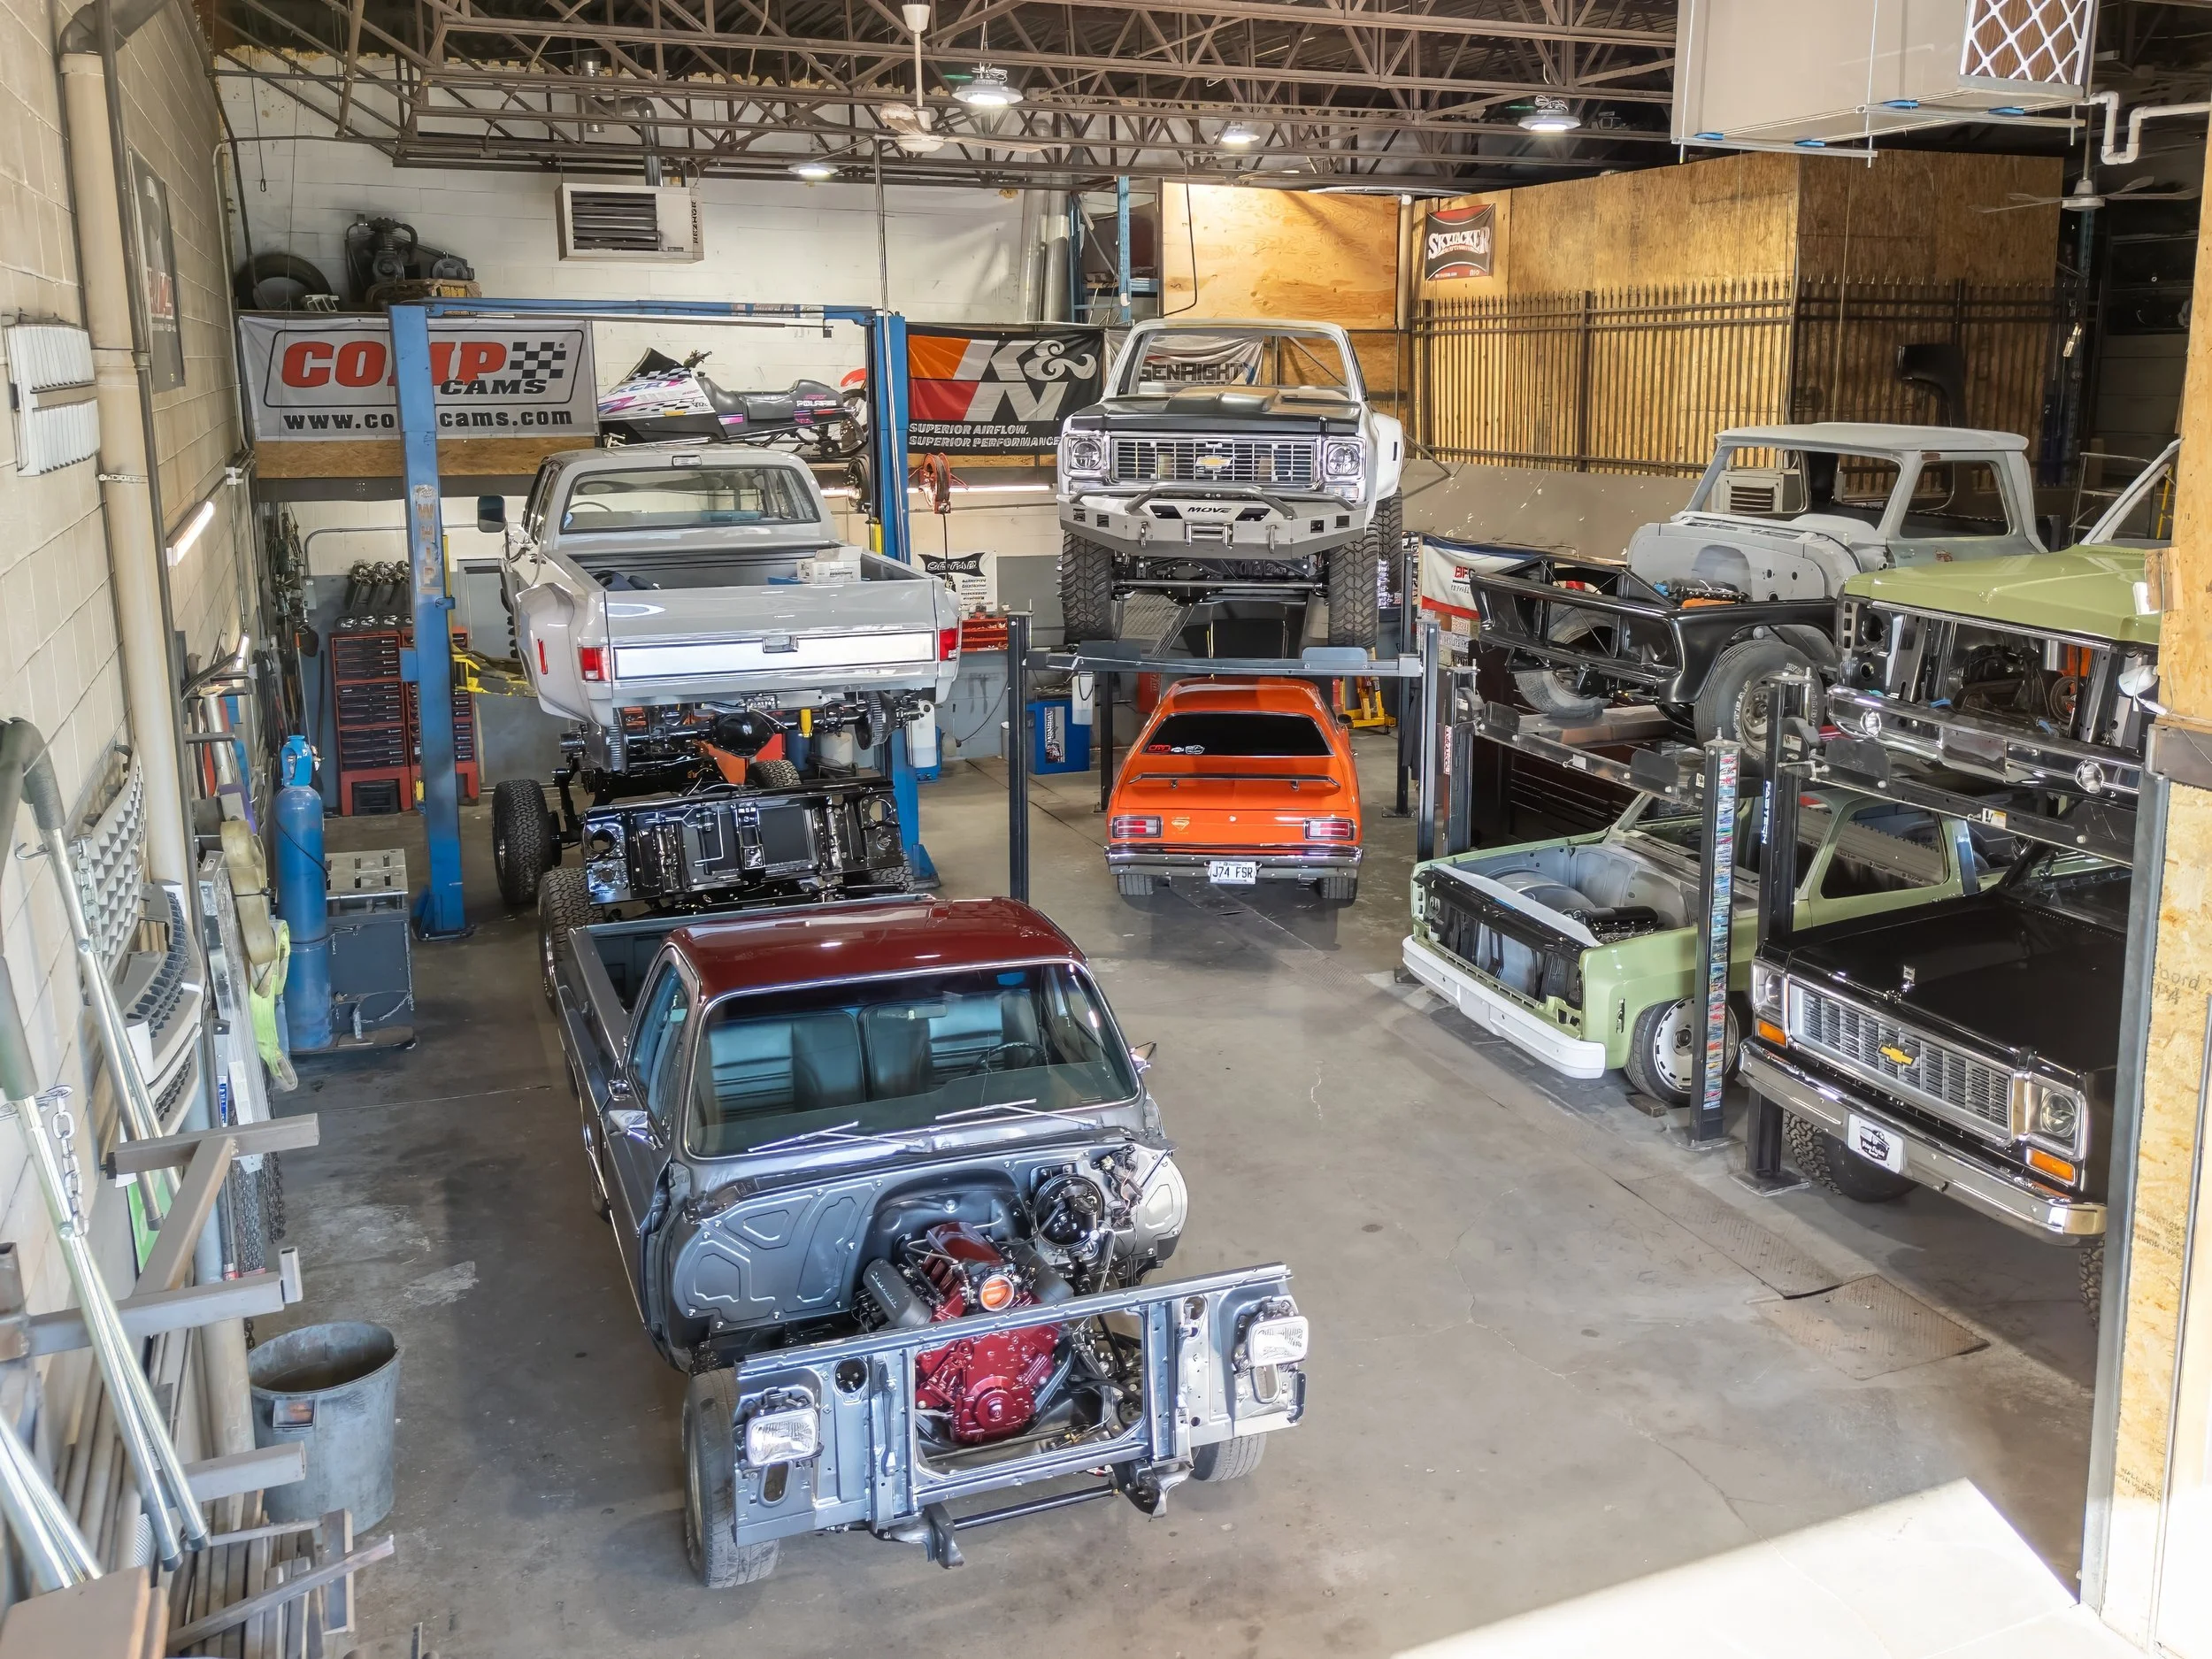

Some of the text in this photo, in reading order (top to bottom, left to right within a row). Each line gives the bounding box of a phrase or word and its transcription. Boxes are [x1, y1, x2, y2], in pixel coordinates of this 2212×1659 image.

[1428, 226, 1491, 260] SKYJACKER
[440, 379, 547, 395] CAMS
[909, 423, 1029, 434] SUPERIOR AIRFLOW,
[909, 436, 1062, 448] SUPERIOR PERFORMANCE
[1762, 780, 1771, 845] FABTECH
[1212, 865, 1253, 879] J74 FSR
